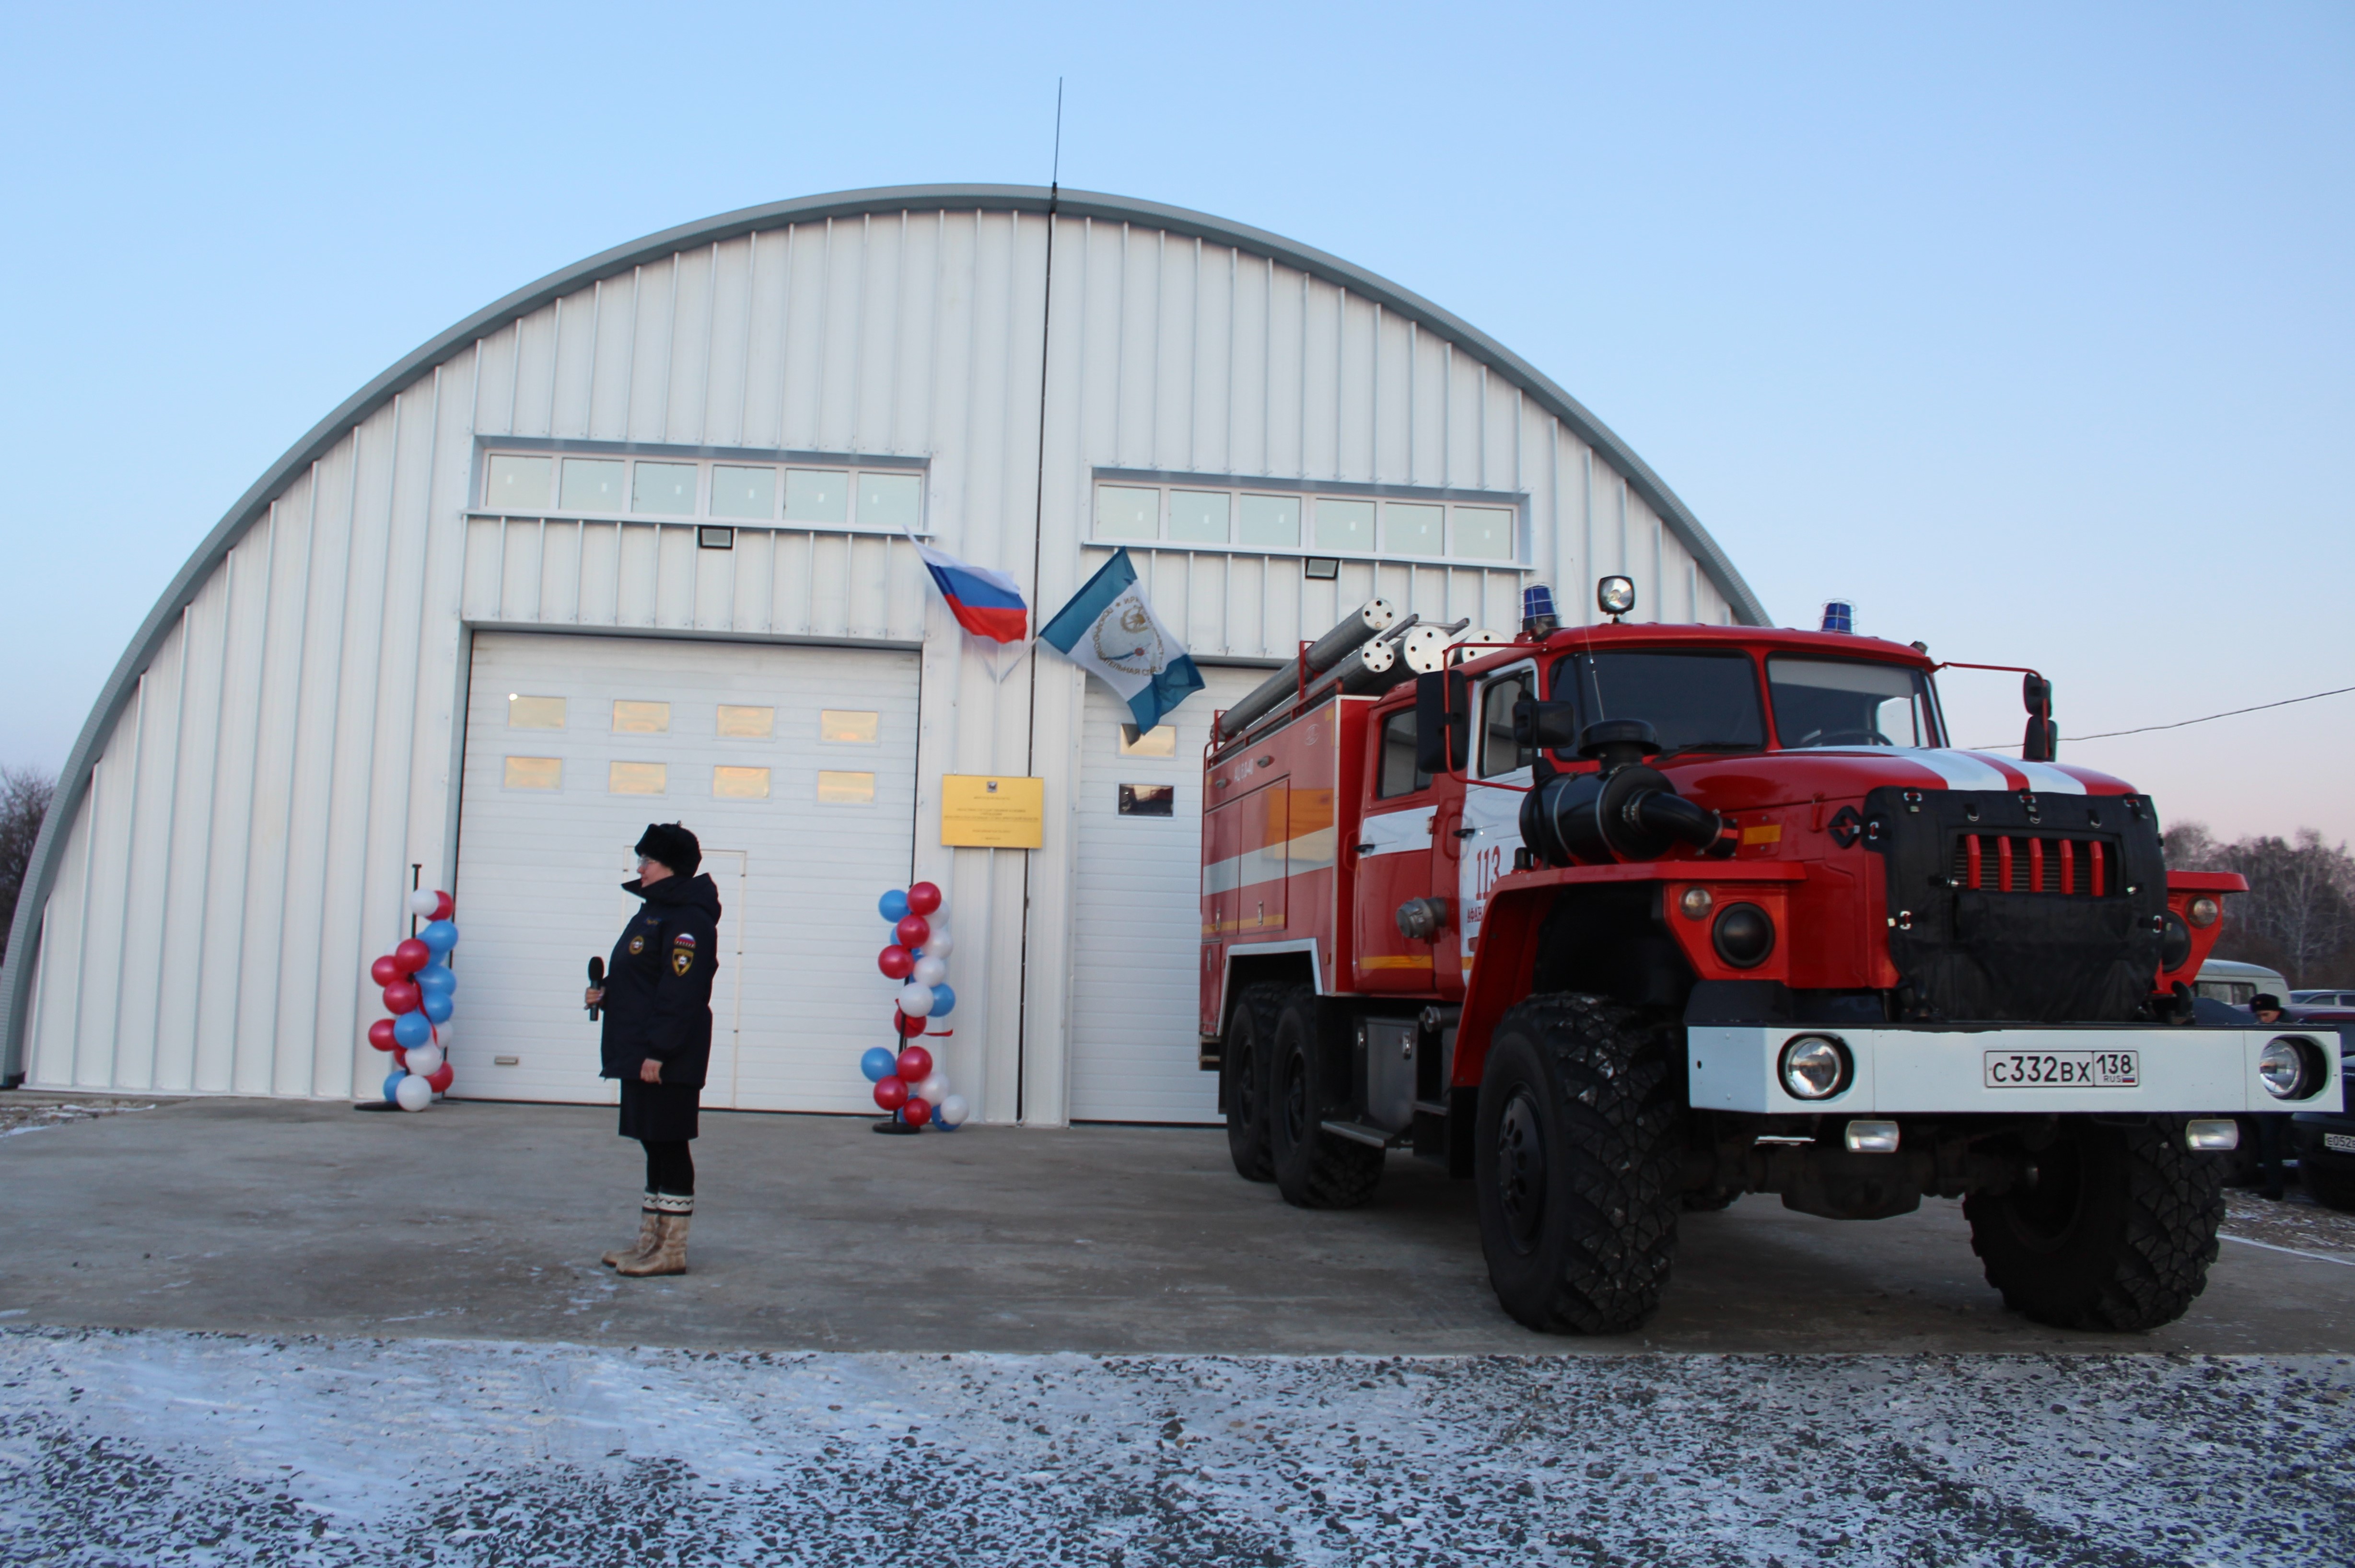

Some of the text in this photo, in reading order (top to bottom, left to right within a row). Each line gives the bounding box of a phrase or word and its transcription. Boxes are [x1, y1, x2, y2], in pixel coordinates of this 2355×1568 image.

[1476, 845, 1500, 901] 113
[1993, 1054, 2132, 1082] С332ВХ 138
